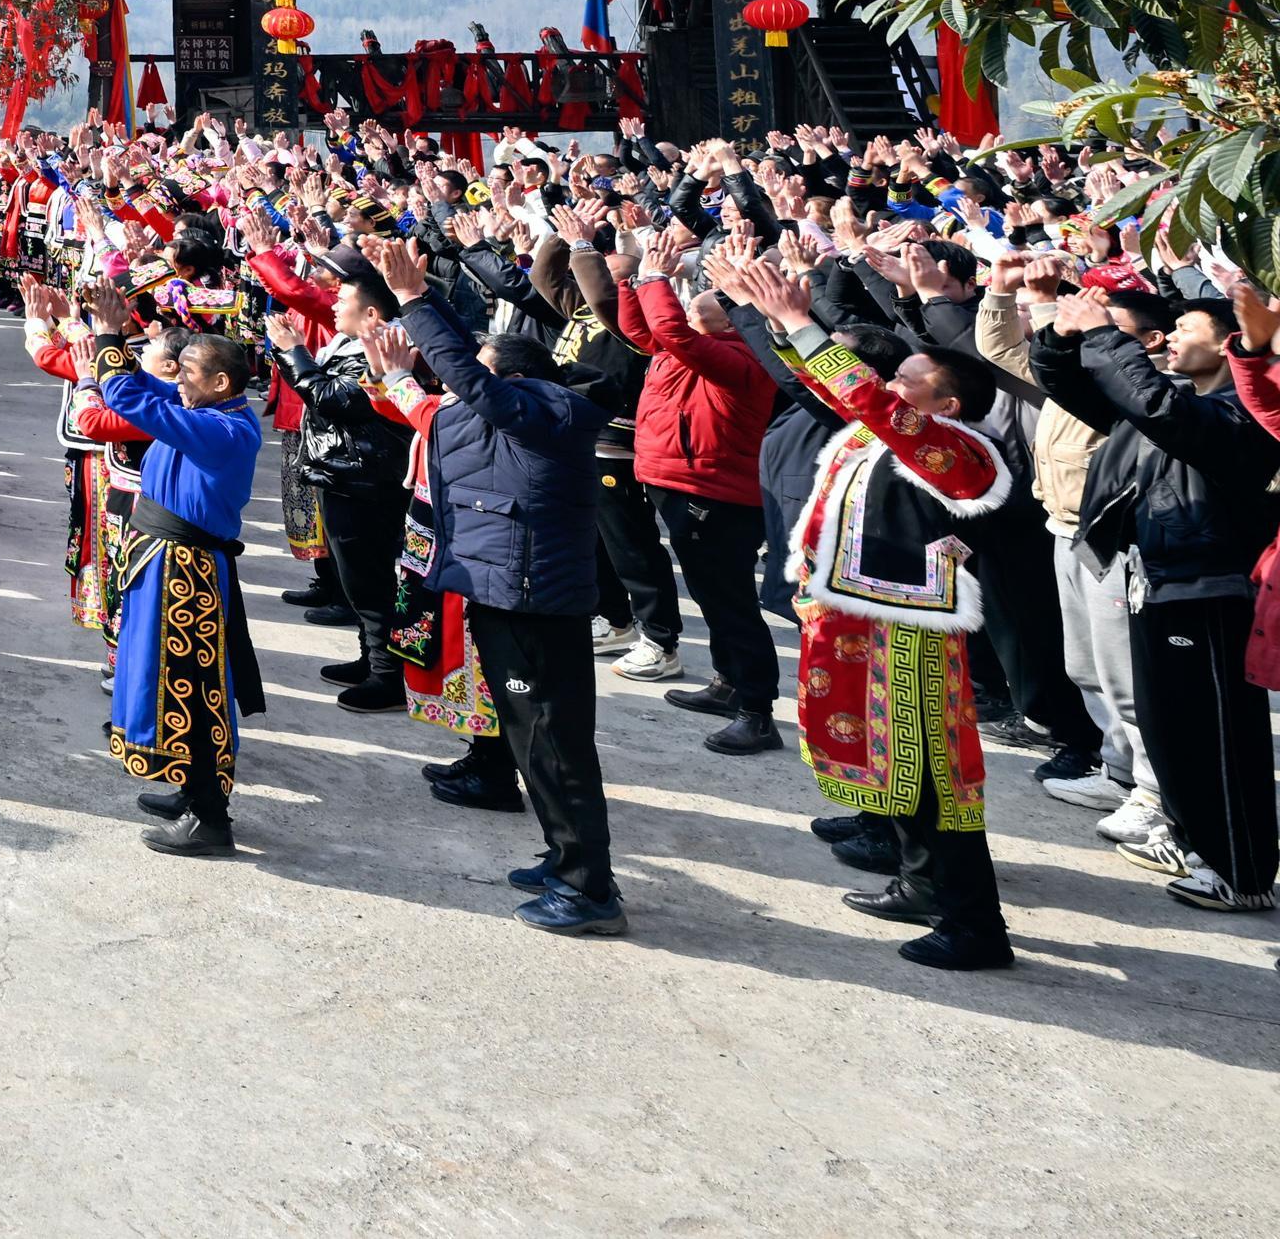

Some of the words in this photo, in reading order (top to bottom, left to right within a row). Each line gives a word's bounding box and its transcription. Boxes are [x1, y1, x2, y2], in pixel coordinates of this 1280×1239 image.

[179, 38, 230, 49] 木梯年久
[180, 49, 230, 60] 禁止攀爬
[180, 60, 230, 70] 后果自负
